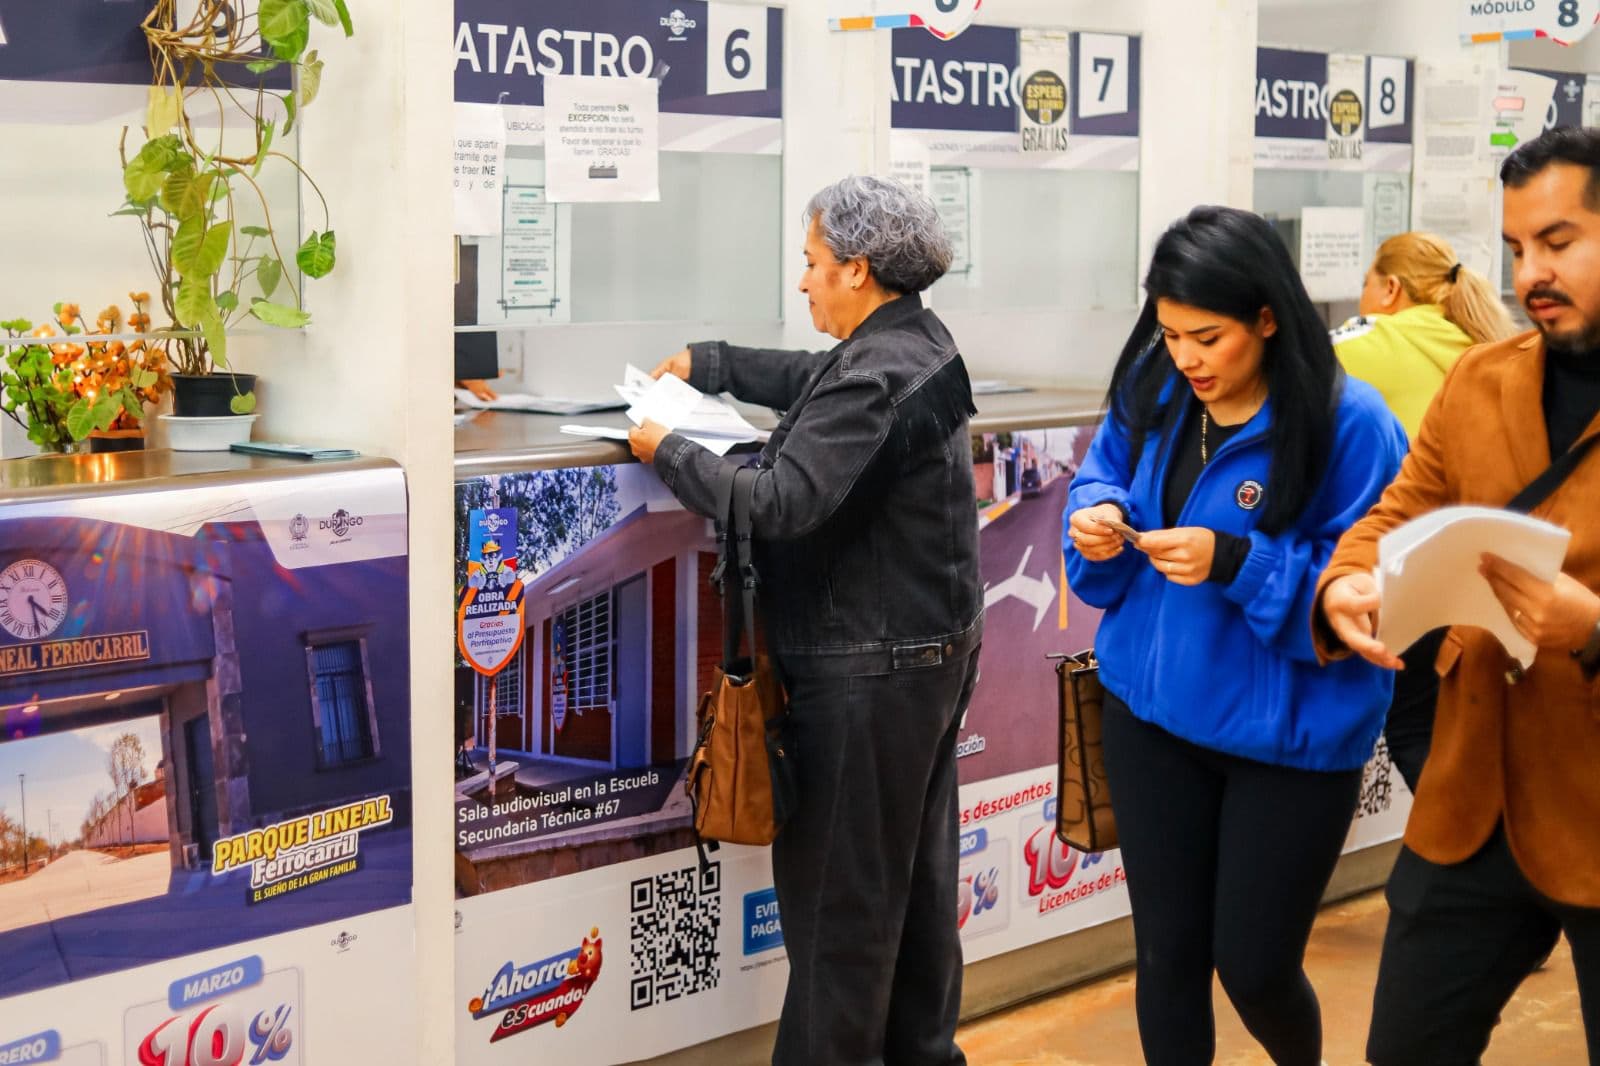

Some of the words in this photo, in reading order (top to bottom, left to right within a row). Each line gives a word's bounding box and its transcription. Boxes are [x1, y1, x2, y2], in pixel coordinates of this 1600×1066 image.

[1557, 0, 1580, 28] 8
[452, 21, 654, 79] ATASTRO
[723, 28, 752, 80] 6
[1092, 56, 1115, 102] 7
[1379, 77, 1396, 115] 8
[617, 104, 629, 112] SIN
[457, 140, 472, 150] que
[1022, 127, 1068, 152] GRACIAS
[462, 165, 480, 175] traer
[481, 166, 496, 176] INE
[483, 154, 497, 164] que
[465, 601, 518, 616] REALIZADA
[478, 591, 505, 603] OBRA
[41, 634, 147, 668] FERROCARRIL
[458, 804, 489, 824] Sala
[492, 787, 572, 817] audiovisual
[574, 785, 592, 800] en
[594, 780, 607, 797] la
[609, 771, 660, 793] Escuela
[973, 781, 1053, 820] descuentos
[213, 817, 310, 874] PARQUE
[311, 797, 392, 842] LINEAL
[458, 818, 538, 846] Secundaria
[541, 806, 592, 829] Técnica
[594, 799, 621, 819] #67
[252, 833, 358, 887] Ferrocarril
[254, 889, 262, 902] EL
[264, 881, 288, 899] SUEÑO
[288, 878, 298, 891] DE
[299, 875, 309, 888] LA
[309, 869, 329, 883] GRAN
[329, 859, 358, 878] FAMILIA
[1039, 881, 1095, 914] Licencias
[1097, 872, 1112, 891] de
[183, 966, 245, 1002] MARZO
